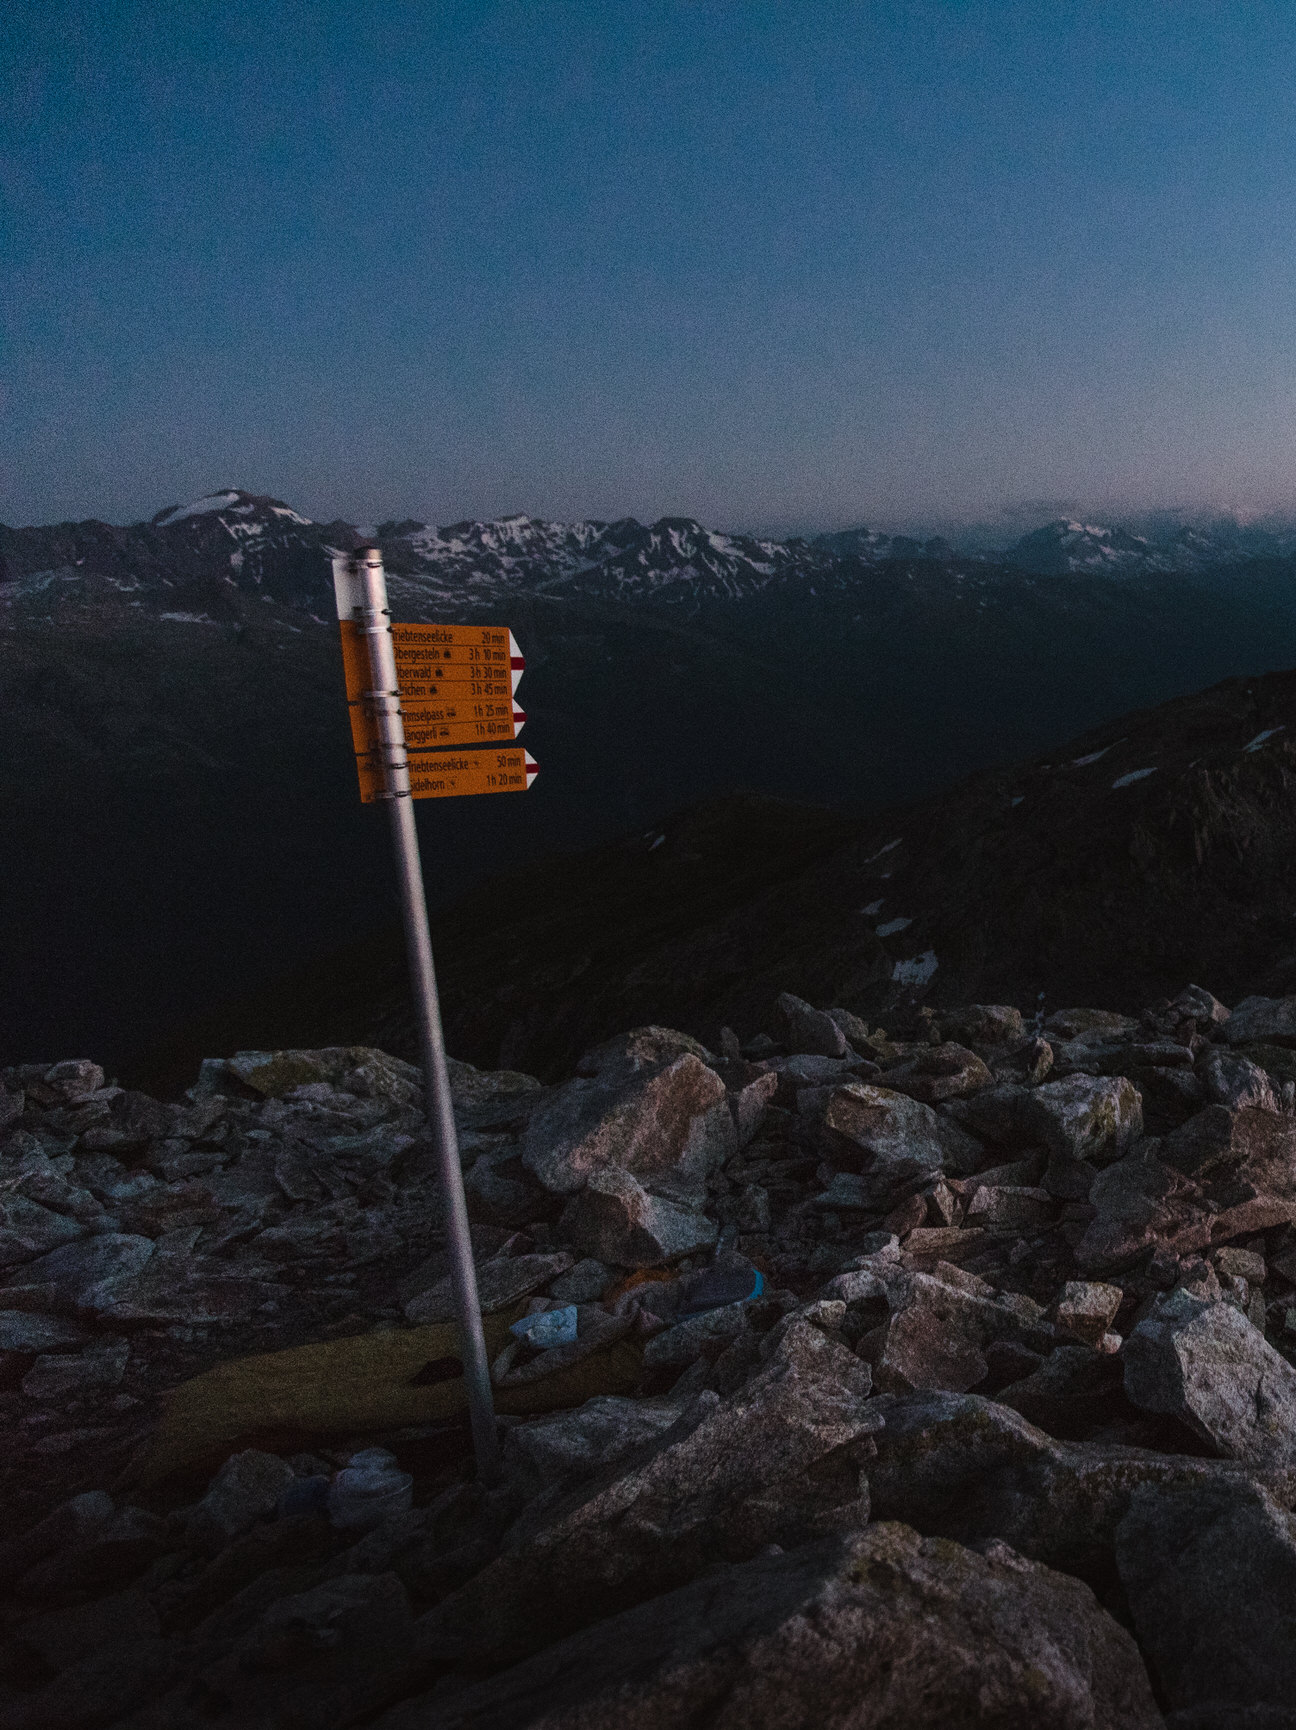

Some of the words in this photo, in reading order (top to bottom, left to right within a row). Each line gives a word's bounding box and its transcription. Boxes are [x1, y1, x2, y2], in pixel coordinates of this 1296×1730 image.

[481, 631, 491, 644] 20
[492, 632, 505, 644] min
[484, 649, 491, 660] 10
[492, 649, 506, 661] min
[484, 666, 493, 678] 30
[494, 667, 507, 678] min
[484, 684, 493, 695] 45
[494, 684, 508, 695] min
[485, 705, 495, 717] 25
[495, 704, 509, 716] min
[487, 723, 496, 735] 40
[497, 722, 510, 734] min
[497, 755, 506, 768] 50
[507, 755, 521, 767] min
[499, 774, 508, 786] 20
[509, 772, 522, 785] min
